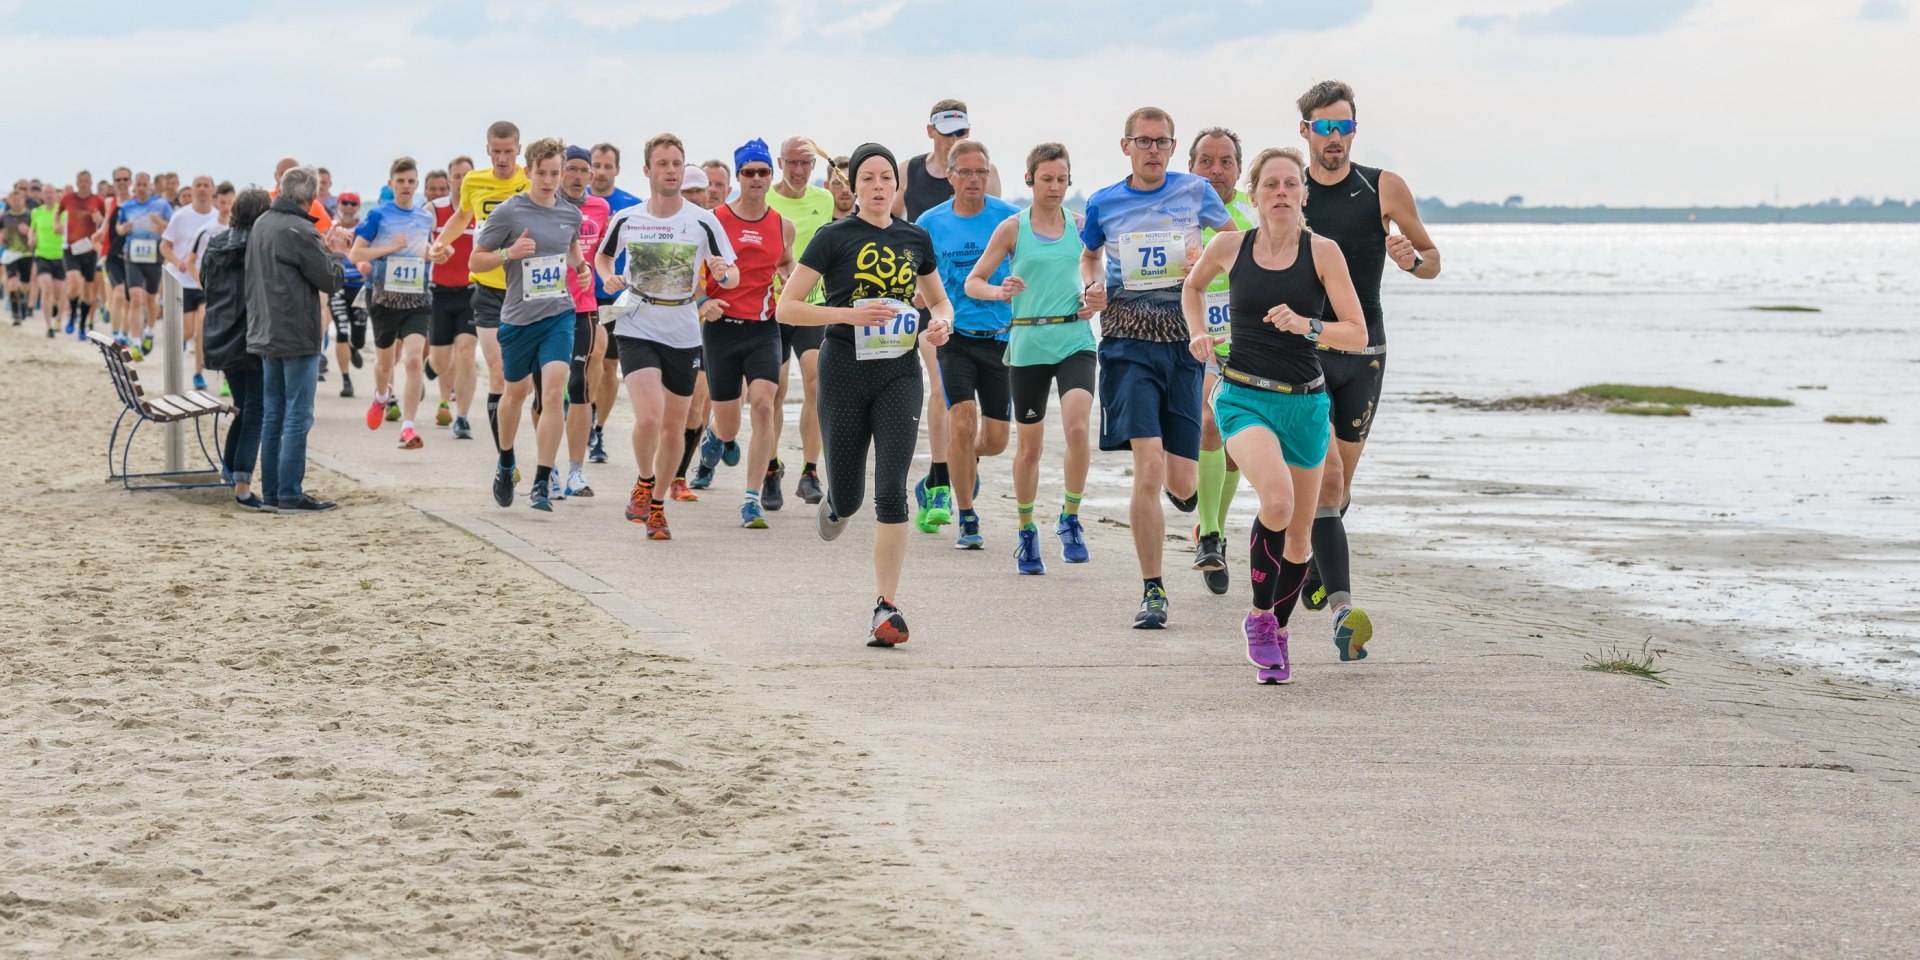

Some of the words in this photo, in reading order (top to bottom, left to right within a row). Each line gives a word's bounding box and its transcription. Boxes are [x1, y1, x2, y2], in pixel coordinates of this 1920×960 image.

[1145, 232, 1172, 241] NORDSEE
[963, 241, 980, 250] 48.
[1137, 246, 1167, 268] 75
[393, 265, 418, 280] 411
[531, 266, 561, 285] 544
[1140, 267, 1168, 276] Daniel
[1208, 325, 1226, 333] Kurt
